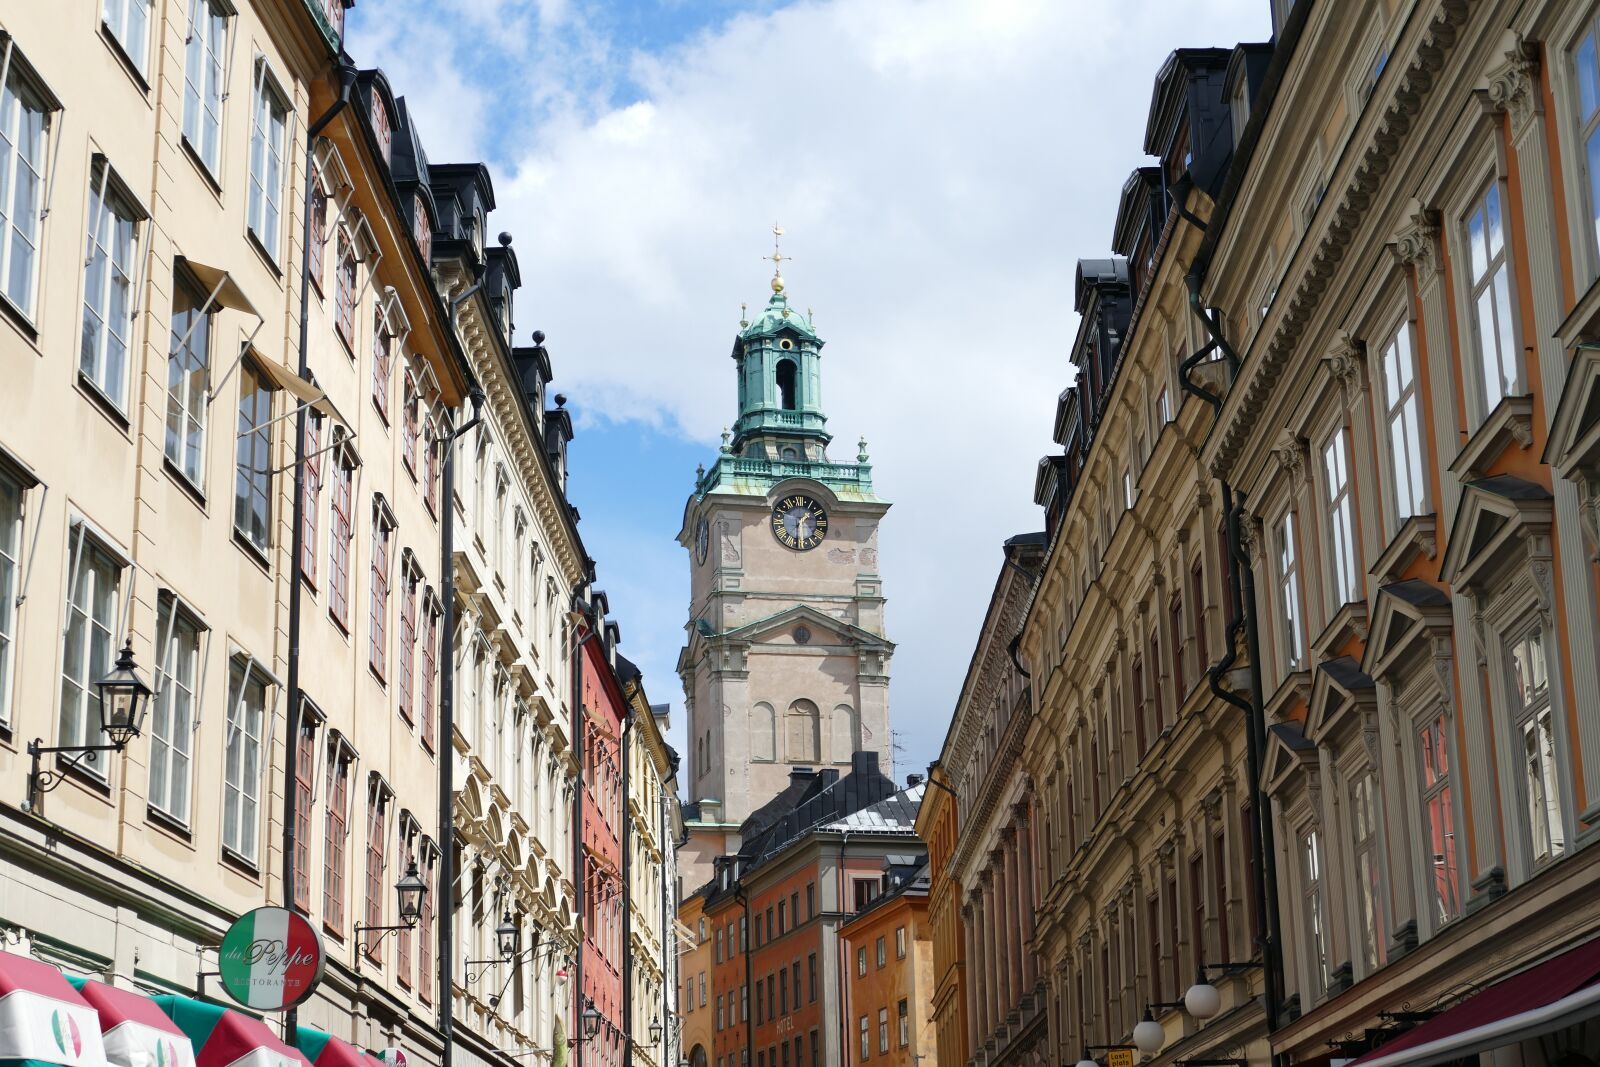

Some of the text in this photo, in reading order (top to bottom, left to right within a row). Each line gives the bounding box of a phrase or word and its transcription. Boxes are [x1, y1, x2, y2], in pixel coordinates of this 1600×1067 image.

[796, 496, 804, 506] XII
[243, 938, 313, 976] Peppe
[776, 1015, 795, 1036] HOTEL
